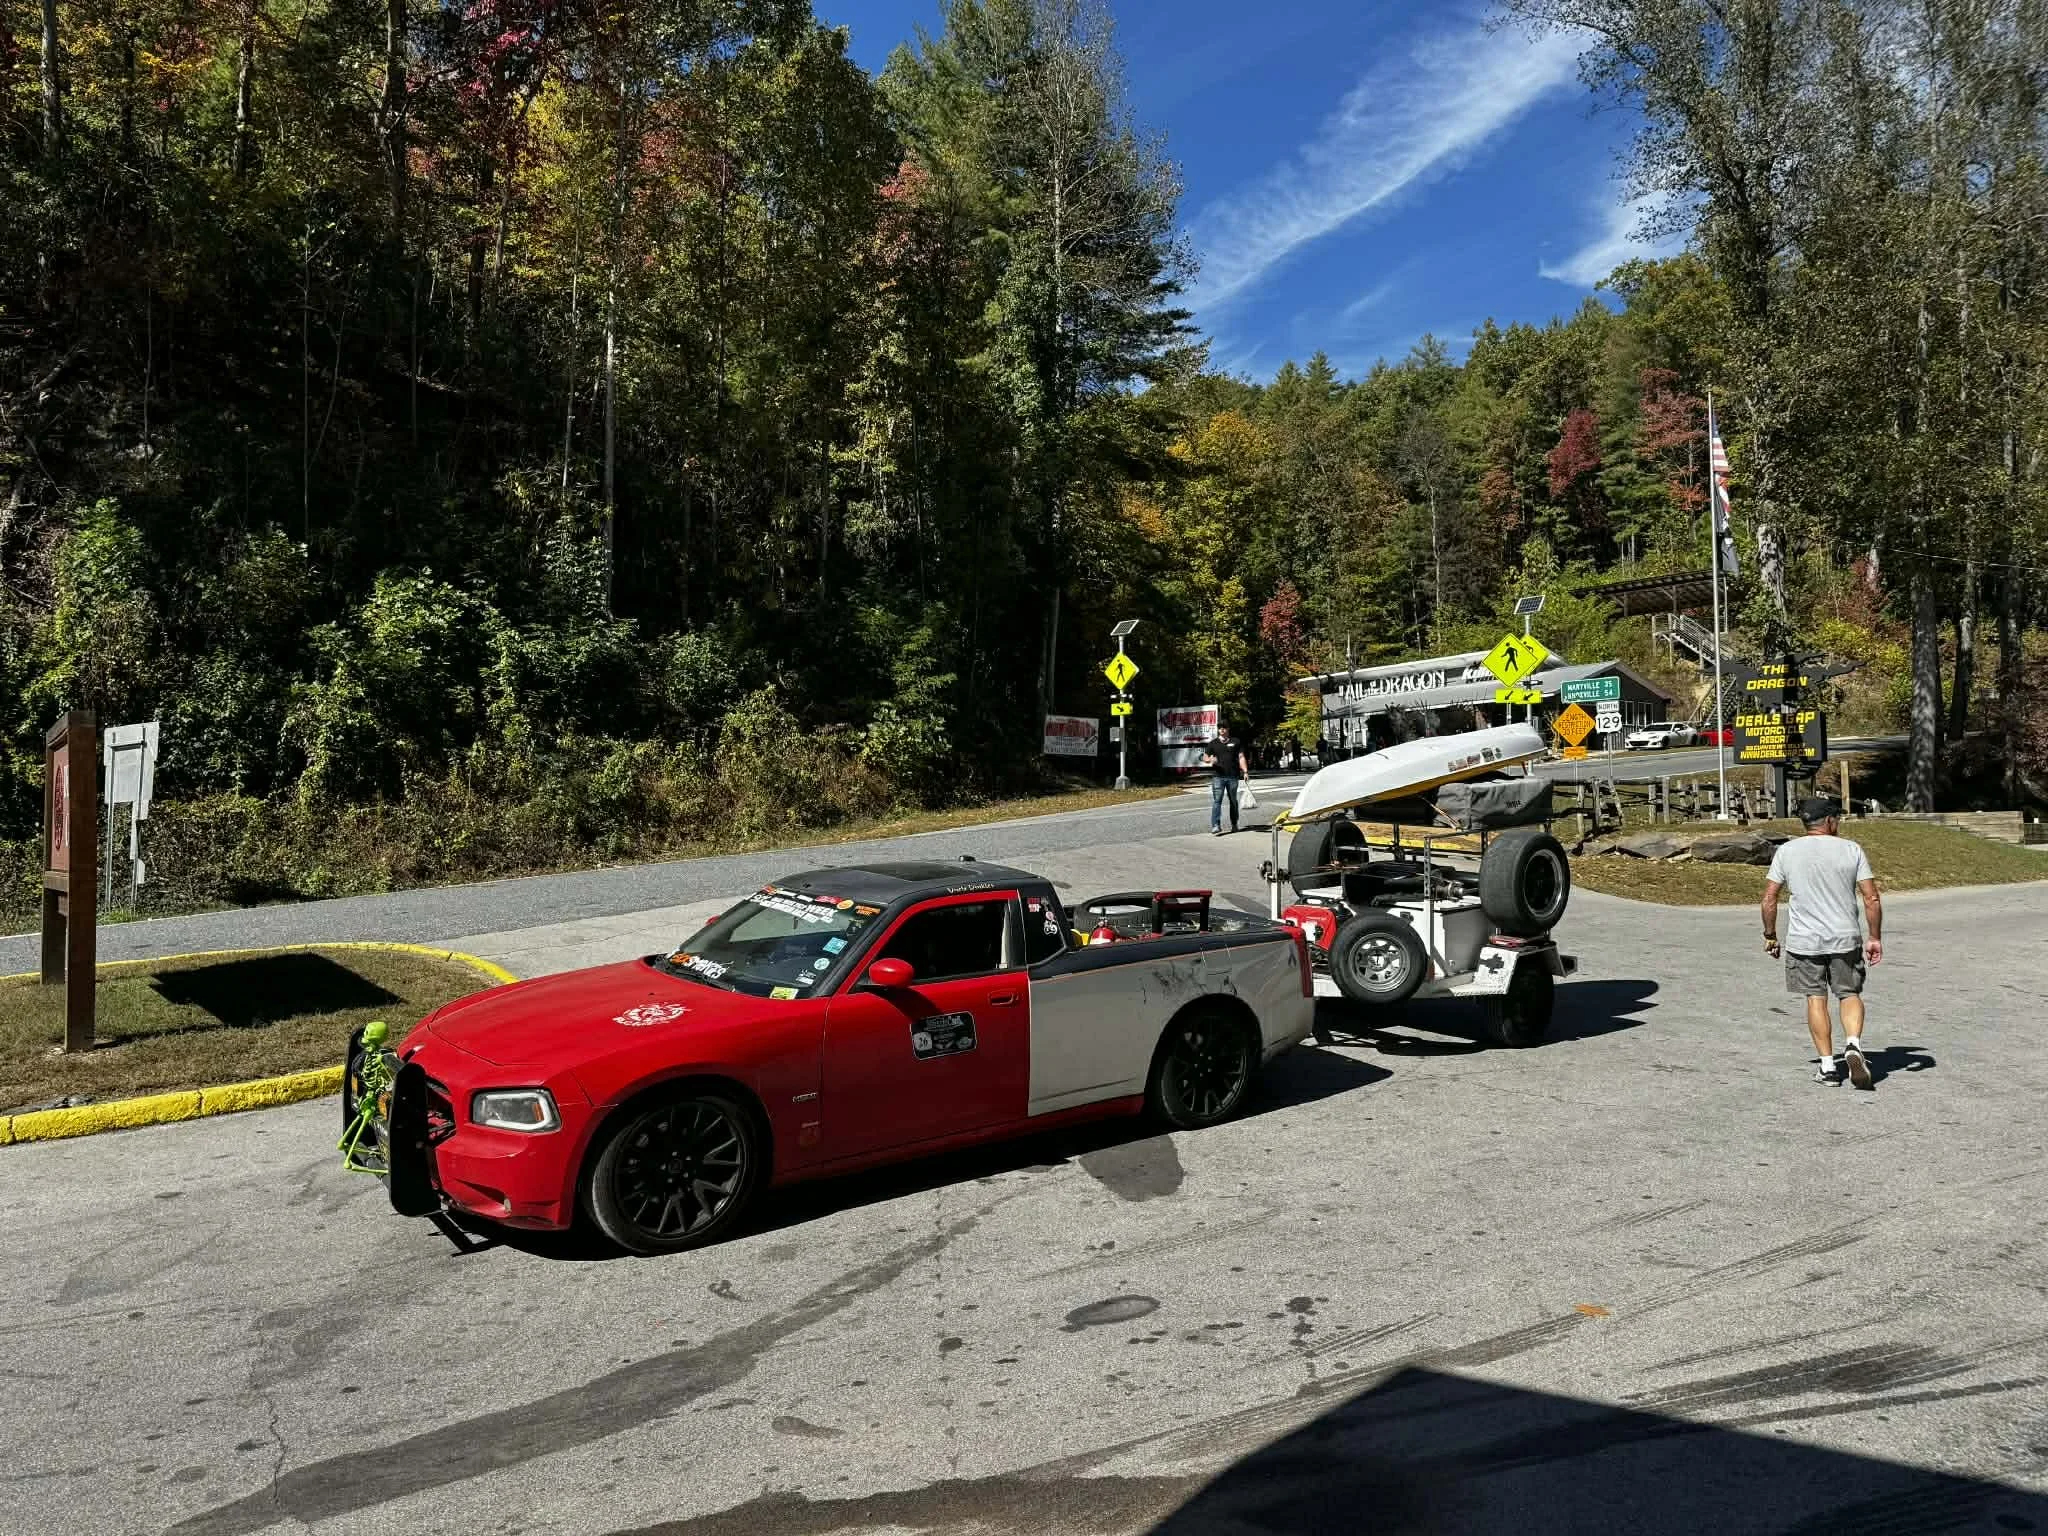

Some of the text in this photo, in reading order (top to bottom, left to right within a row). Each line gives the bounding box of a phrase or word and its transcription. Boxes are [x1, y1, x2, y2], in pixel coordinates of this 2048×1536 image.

[1761, 664, 1789, 675] THE
[1380, 669, 1446, 695] DRAGON
[1746, 676, 1808, 690] DRAGON
[1604, 689, 1613, 697] 54
[1598, 703, 1618, 711] NORTH
[1597, 716, 1620, 729] 129
[1736, 711, 1816, 728] DEALS GAP
[1745, 724, 1806, 737] MOTORCYCLE
